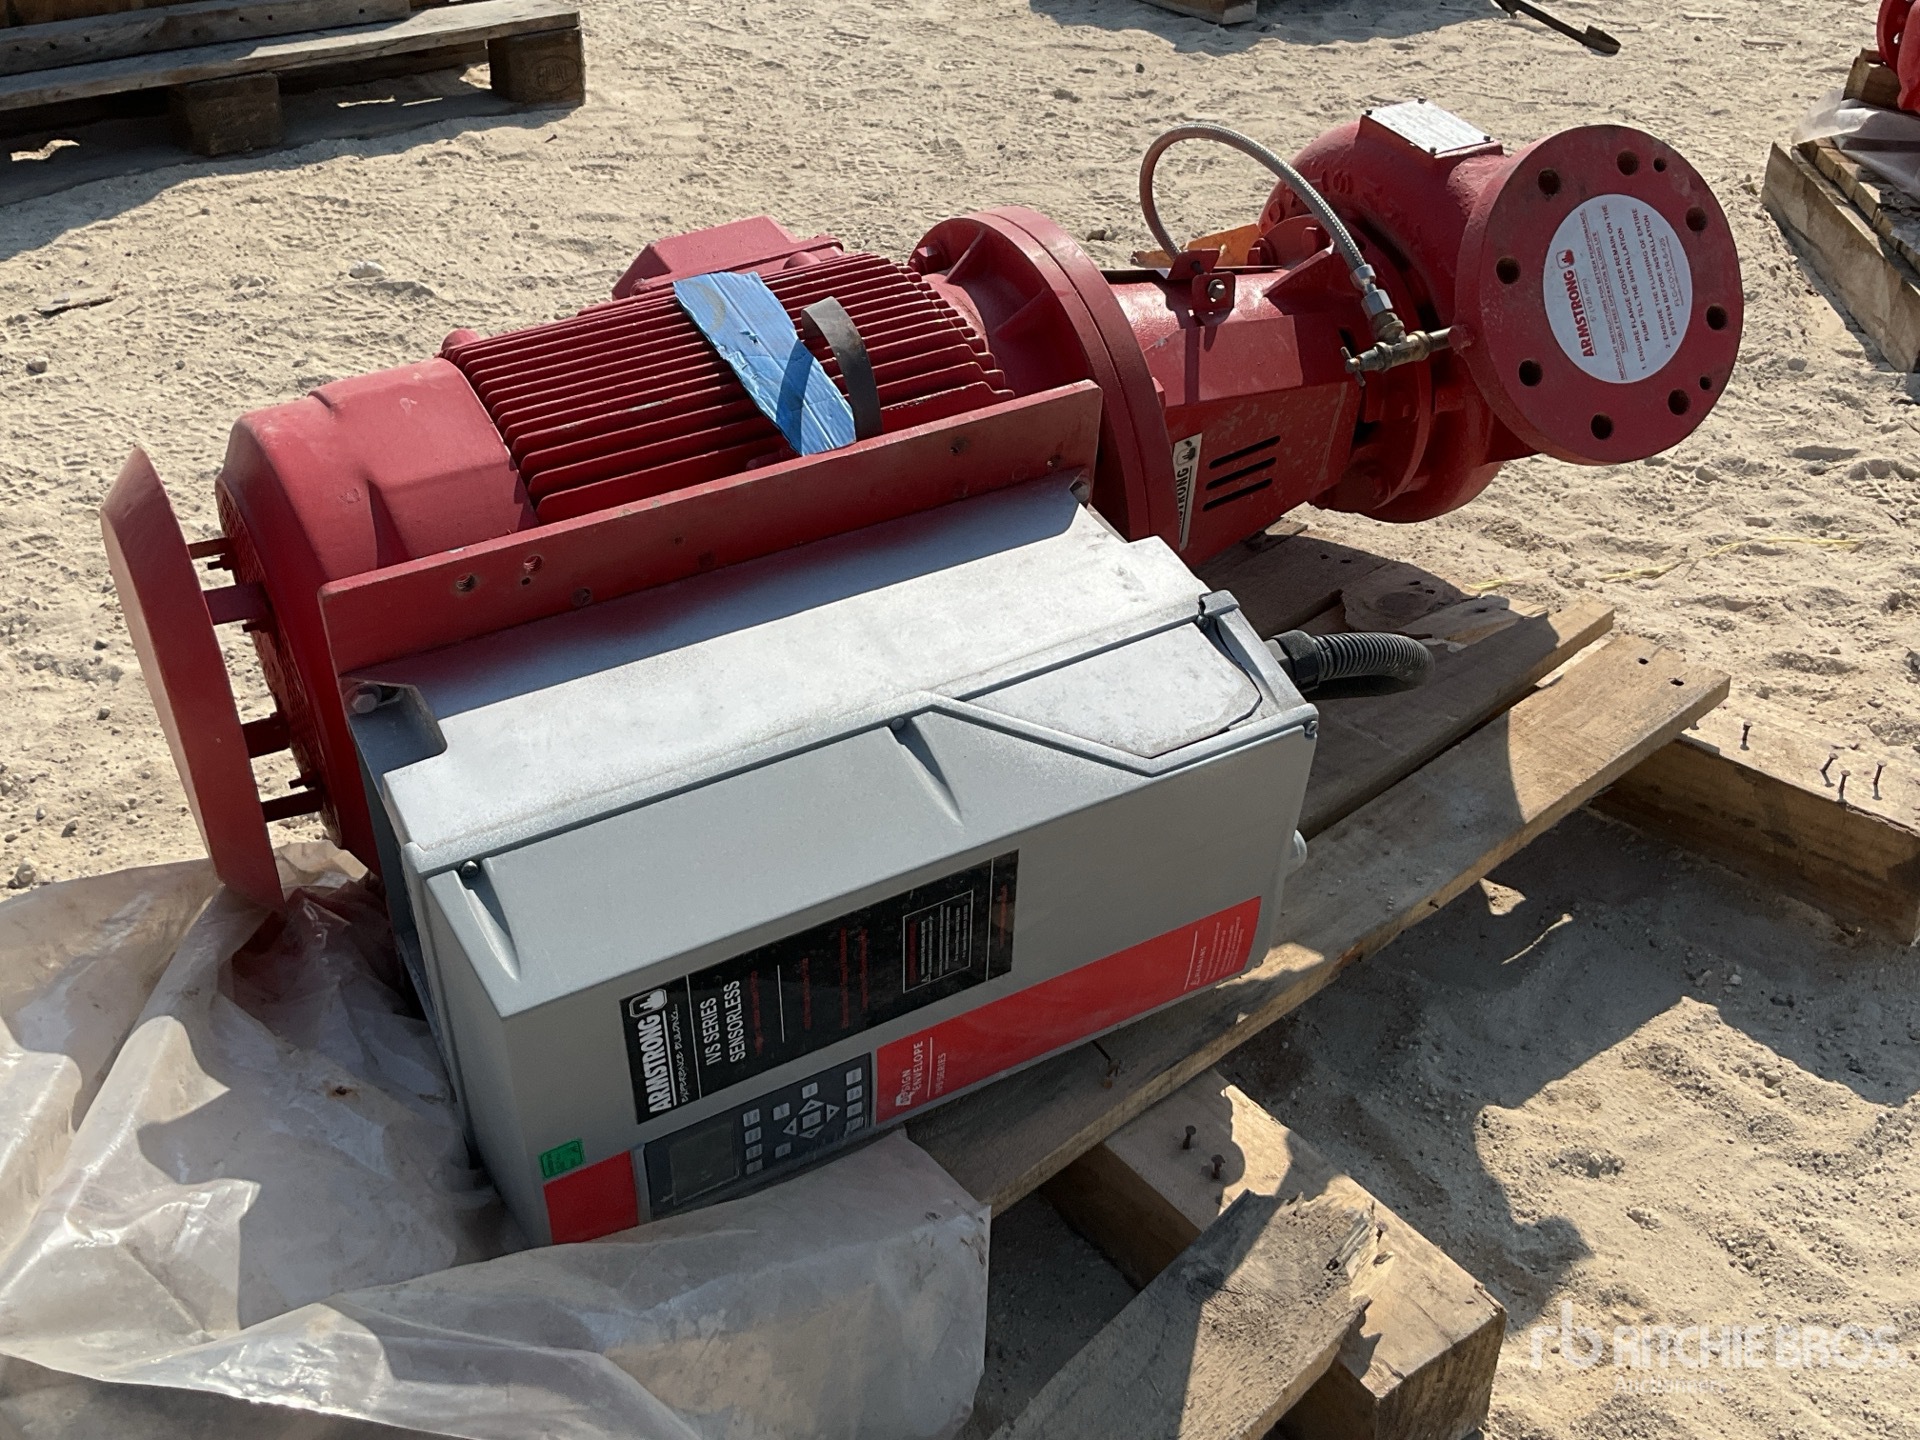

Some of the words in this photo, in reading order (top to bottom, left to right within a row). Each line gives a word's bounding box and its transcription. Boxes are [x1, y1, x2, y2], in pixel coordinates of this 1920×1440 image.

[1602, 205, 1610, 220] THE
[1605, 222, 1613, 234] ON
[1632, 208, 1643, 236] ENTIRE
[1596, 246, 1604, 265] LONG
[1608, 236, 1621, 267] REMAIN
[1617, 227, 1636, 283] INSTALLATION
[1639, 240, 1646, 249] OF
[1643, 215, 1661, 270] INSTALLATION
[1591, 260, 1601, 284] BETTER
[1617, 267, 1629, 295] COVER
[1642, 251, 1657, 290] FLUSHING
[1602, 271, 1615, 306] OPERATION
[1631, 284, 1640, 300] THE
[1652, 291, 1661, 306] THE
[1657, 271, 1669, 303] BEFORE
[1563, 269, 1594, 358] ARMSTRONG
[1602, 300, 1617, 344] INSTRUCTIONS
[1611, 308, 1619, 324] FREE
[1625, 297, 1637, 328] FLANGE
[1636, 302, 1644, 318] TILL
[1657, 309, 1669, 340] ENSURE
[1665, 304, 1677, 336] SYSTEM
[1616, 326, 1626, 353] TROUBLE
[1633, 330, 1645, 362] ENSURE
[1640, 319, 1650, 342] PUMP
[1613, 346, 1625, 381] IMPORTANT
[701, 998, 720, 1045] SERIES
[724, 980, 746, 1063] SENSORLESS
[637, 1014, 671, 1113] ARMSTRONG
[706, 1042, 721, 1064] IVS
[913, 1041, 923, 1091] ENVELOPE
[677, 1051, 689, 1102] EXPERIENCE
